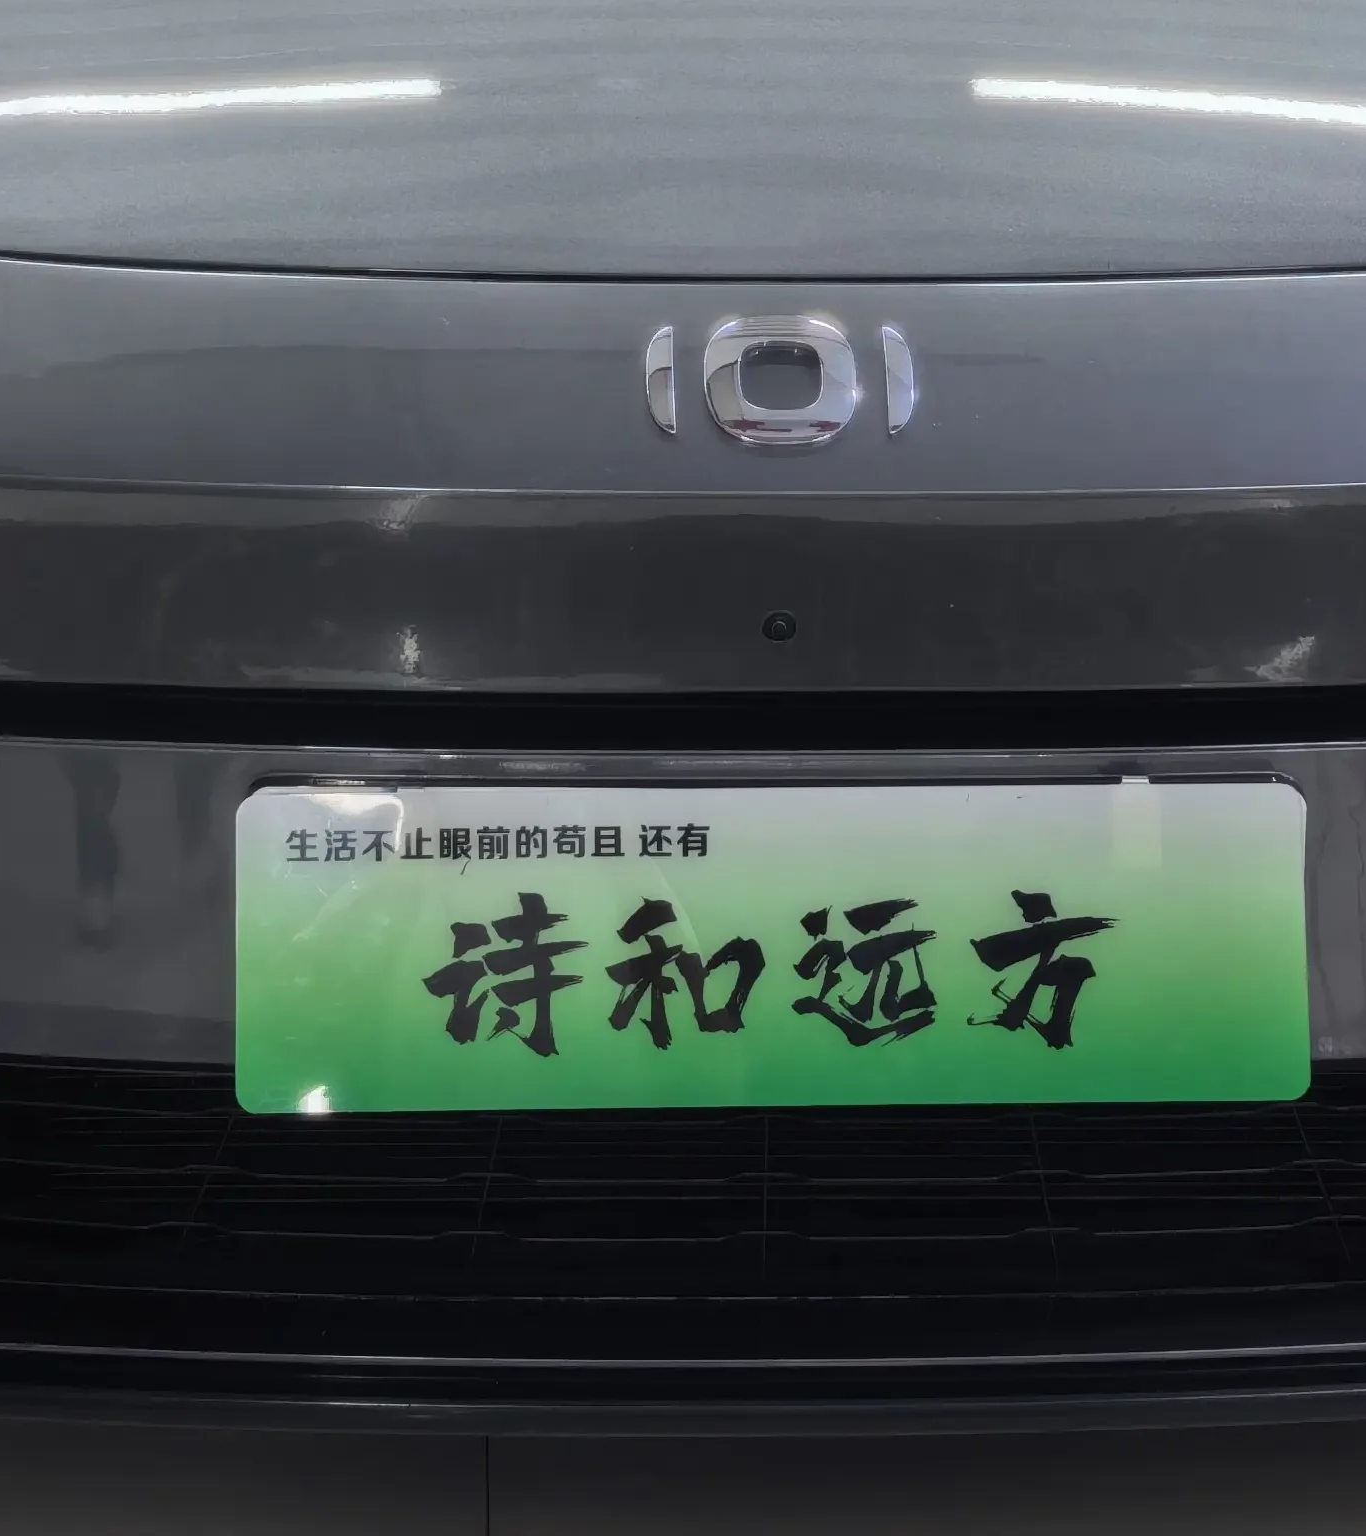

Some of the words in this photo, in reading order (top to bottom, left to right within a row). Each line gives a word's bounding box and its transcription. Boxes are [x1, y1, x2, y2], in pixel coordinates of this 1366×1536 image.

[285, 824, 626, 863] 生活不止眼前的苟且
[638, 822, 711, 859] 还有
[421, 890, 1122, 1058] 诗和远方
